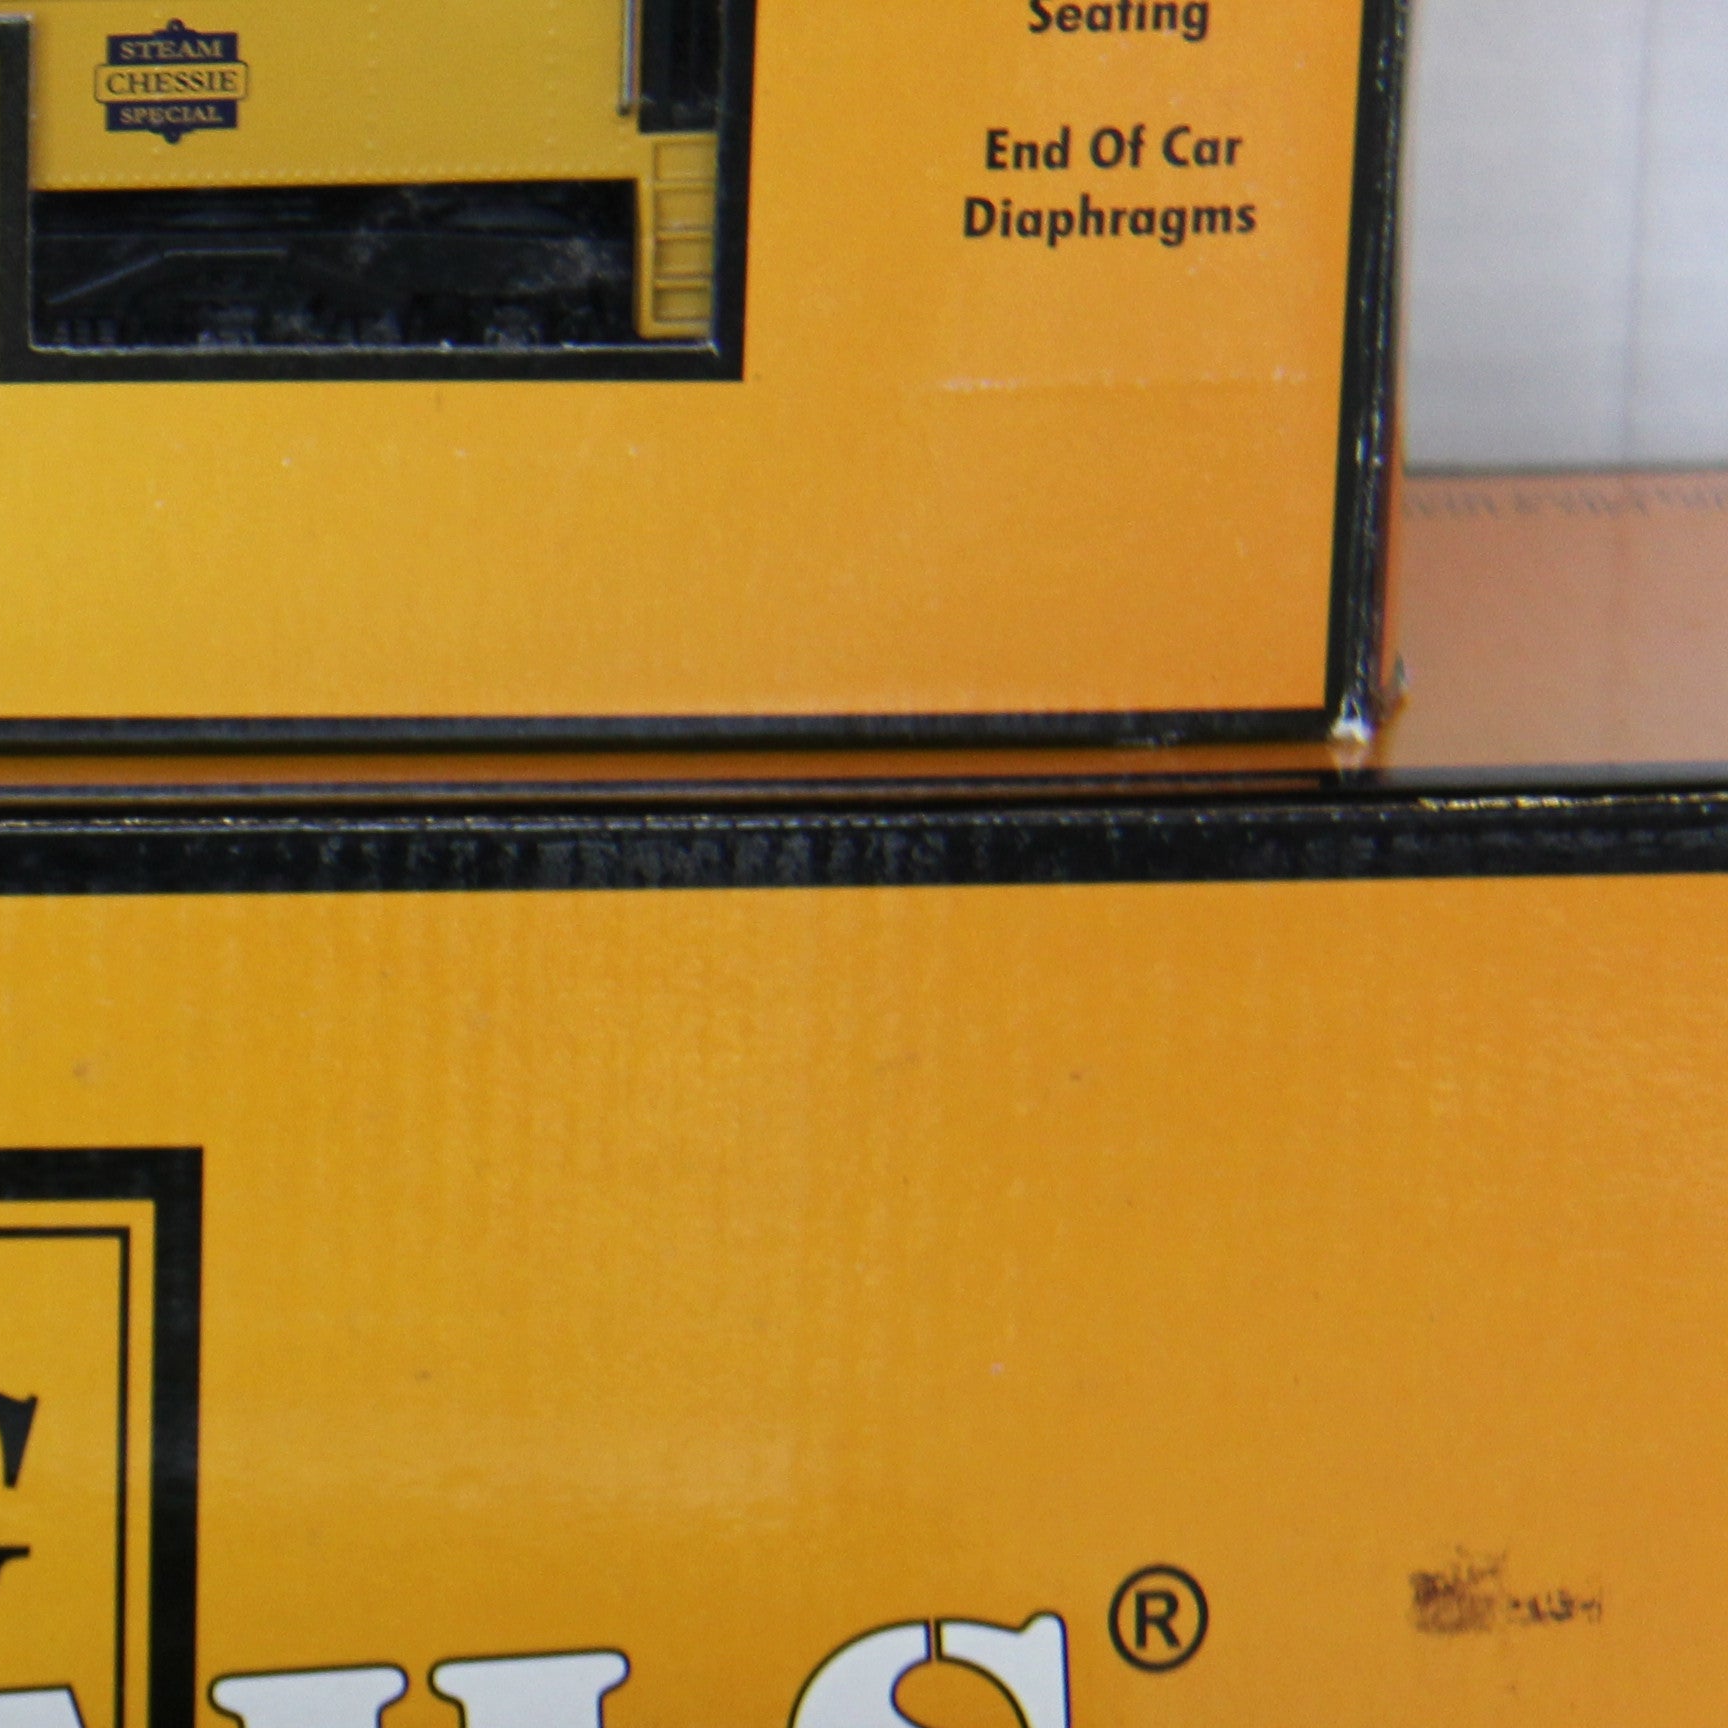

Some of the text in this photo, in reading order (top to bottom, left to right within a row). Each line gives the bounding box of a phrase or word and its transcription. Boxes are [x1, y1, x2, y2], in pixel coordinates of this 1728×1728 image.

[1028, 0, 1210, 42] Seating
[120, 39, 224, 60] STEAM
[107, 70, 238, 95] CHESSIE
[120, 105, 223, 125] SPECIAL
[985, 123, 1243, 171] End Of Car
[963, 193, 1257, 248] Diaphragms
